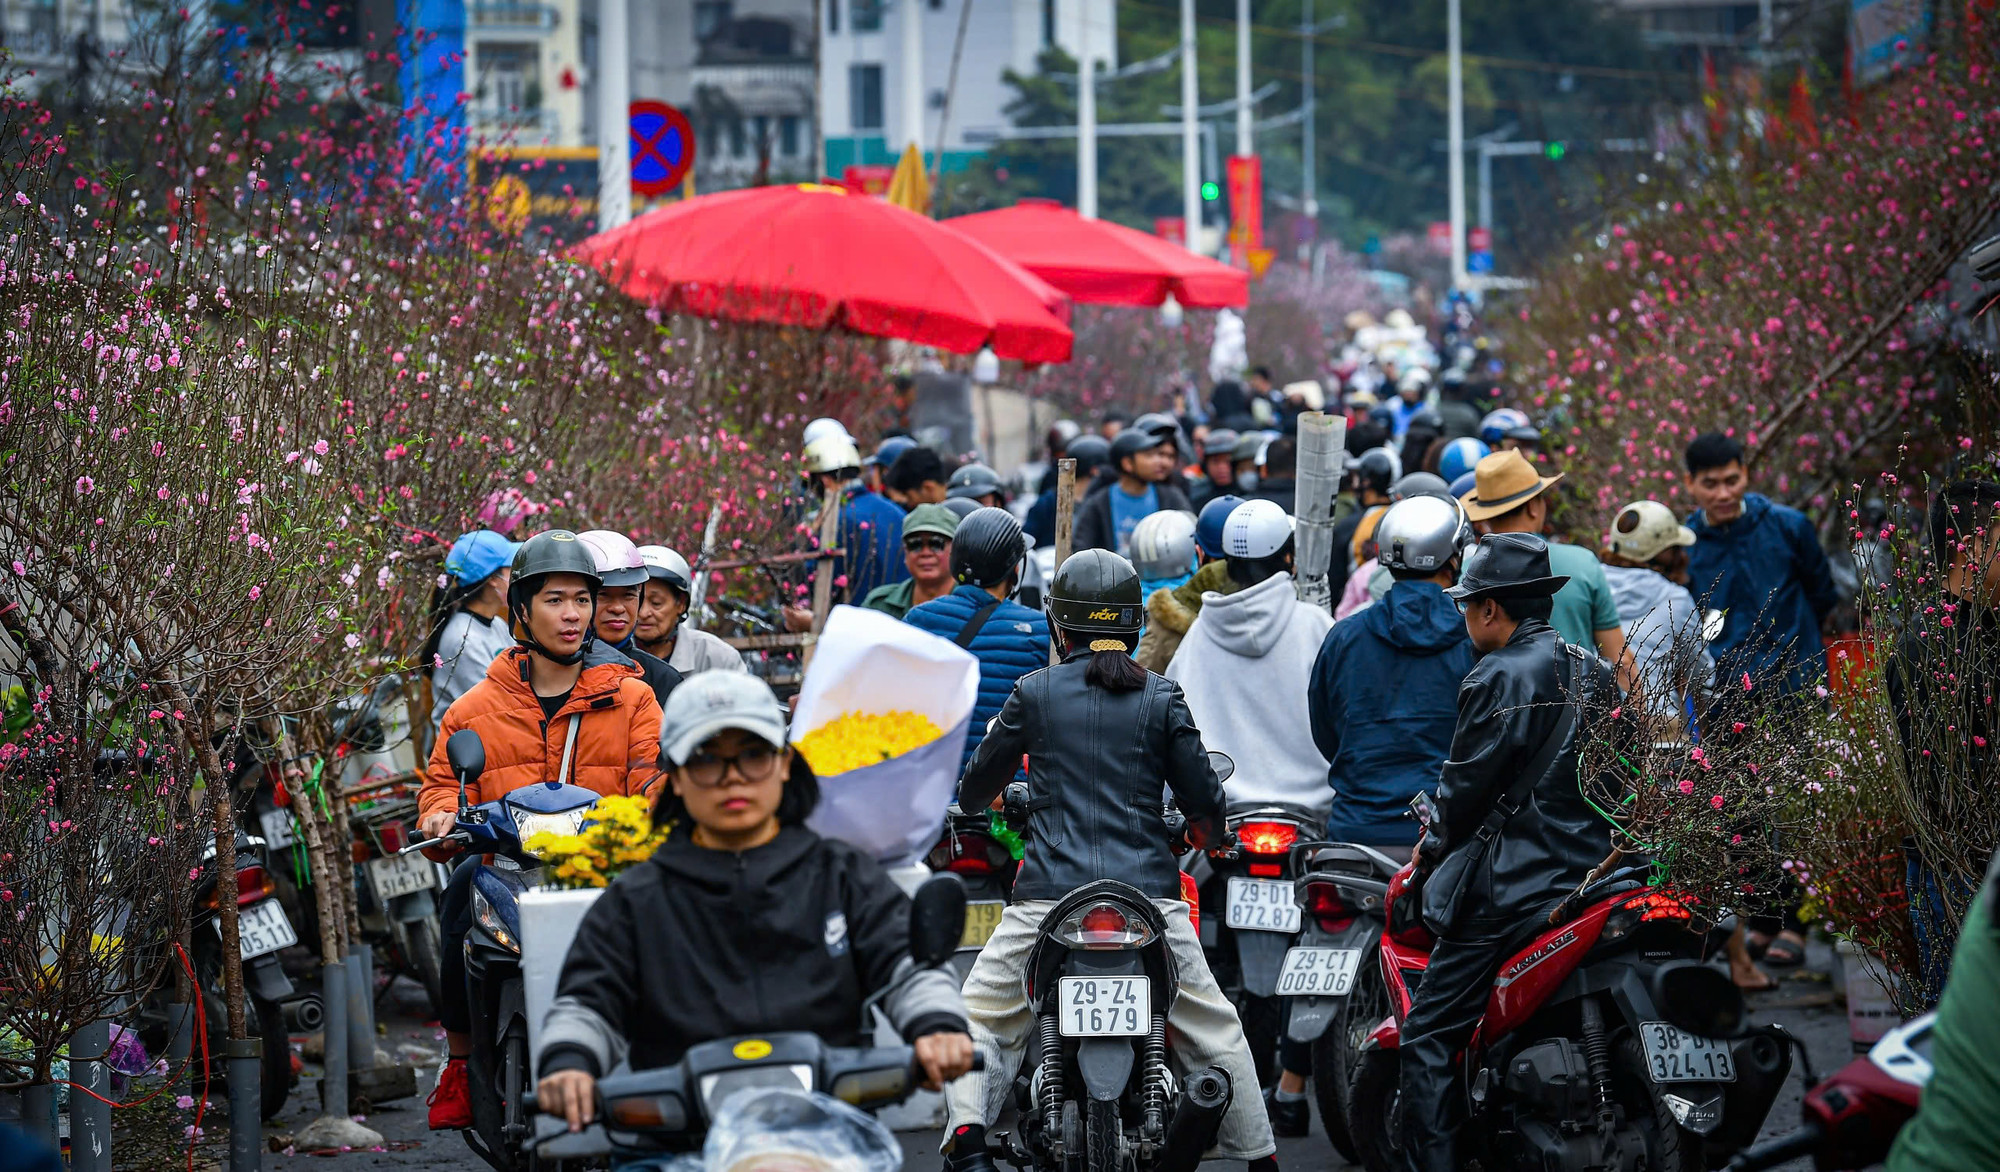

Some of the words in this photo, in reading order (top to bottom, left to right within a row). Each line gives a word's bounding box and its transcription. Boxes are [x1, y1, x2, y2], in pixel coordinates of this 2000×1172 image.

[1240, 882, 1288, 905] 29-D1
[1233, 904, 1294, 928] 872.87
[241, 924, 290, 954] 05.11
[1294, 951, 1348, 970] 29-C1
[1072, 980, 1137, 1005] 29-Z4
[1282, 972, 1348, 991] 009.06
[1074, 1008, 1137, 1032] 1679
[1653, 1052, 1731, 1078] 324.13
